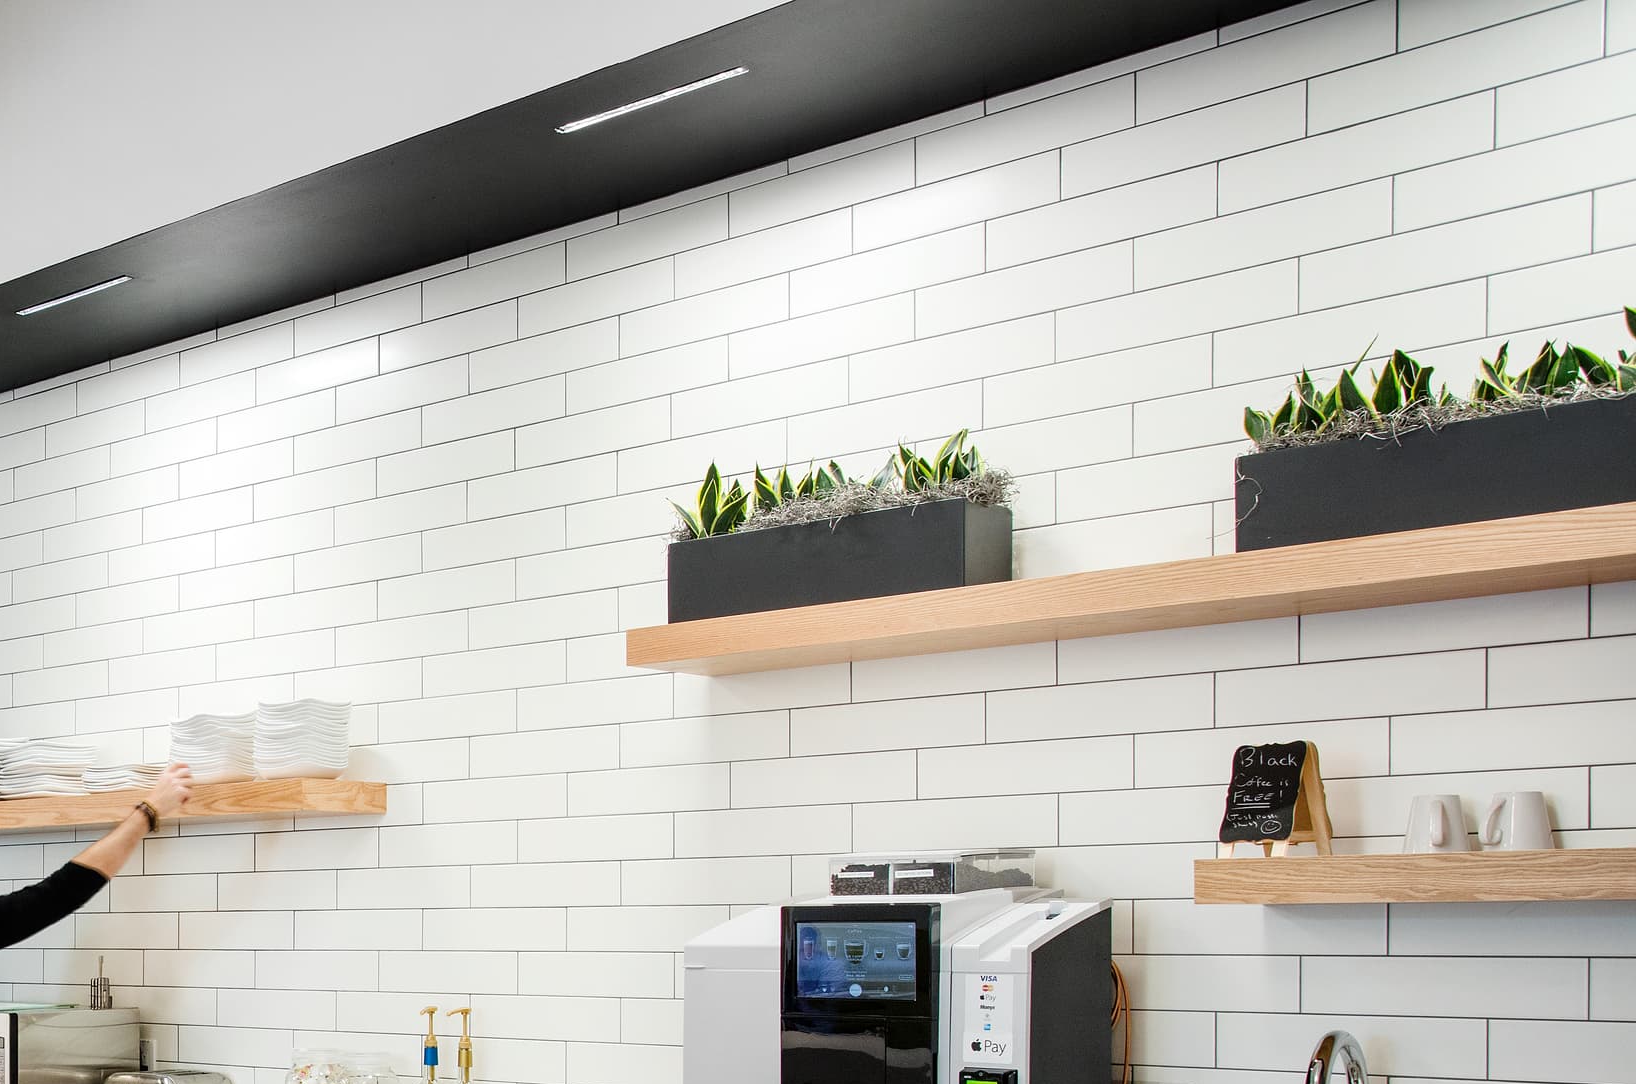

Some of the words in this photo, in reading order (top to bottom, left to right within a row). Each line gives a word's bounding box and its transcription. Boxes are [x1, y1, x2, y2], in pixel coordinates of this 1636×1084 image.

[1239, 746, 1298, 768] Black
[985, 994, 996, 1002] Pay
[984, 1040, 1006, 1056] Pay
